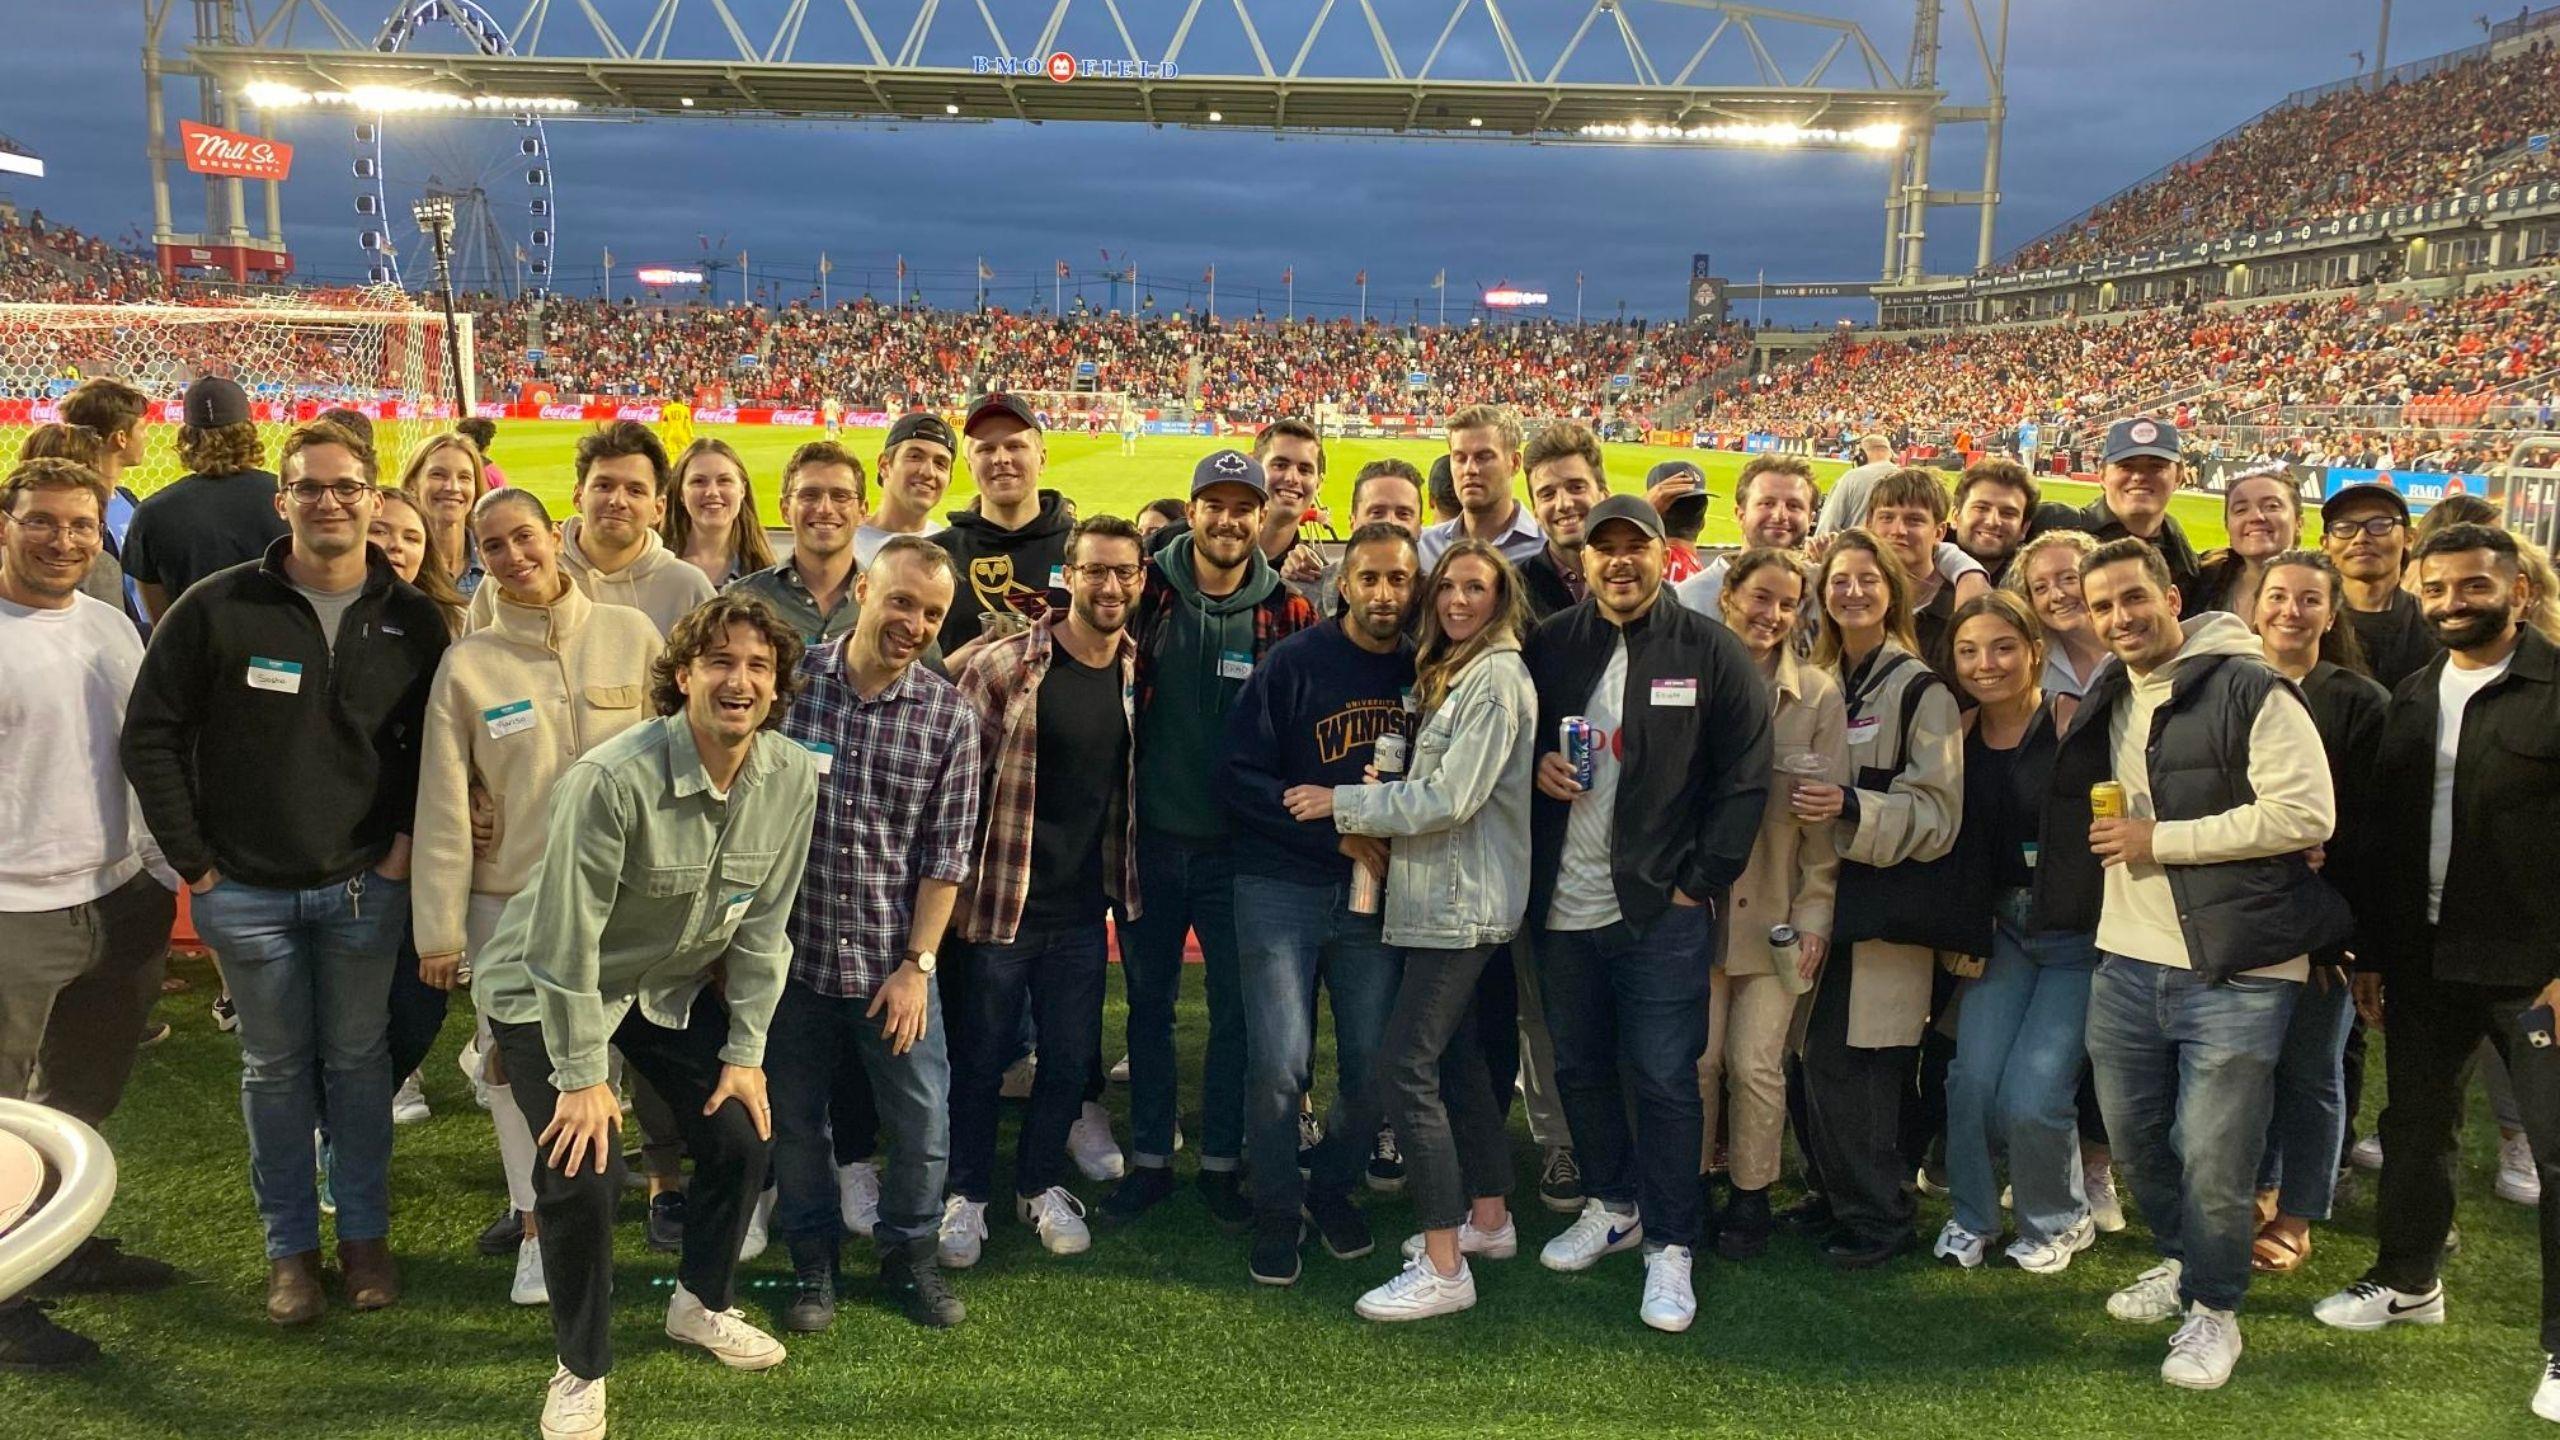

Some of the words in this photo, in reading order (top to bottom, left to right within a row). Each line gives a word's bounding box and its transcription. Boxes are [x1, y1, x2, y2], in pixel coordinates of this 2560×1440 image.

[972, 55, 1041, 76] BMO
[1081, 58, 1180, 80] FIELD
[190, 132, 249, 160] Mill
[249, 144, 280, 164] St.
[1775, 288, 1796, 296] BMO
[1808, 287, 1839, 295] FIELD
[2408, 484, 2442, 499] BMO
[1580, 741, 1591, 782] ULTRA
